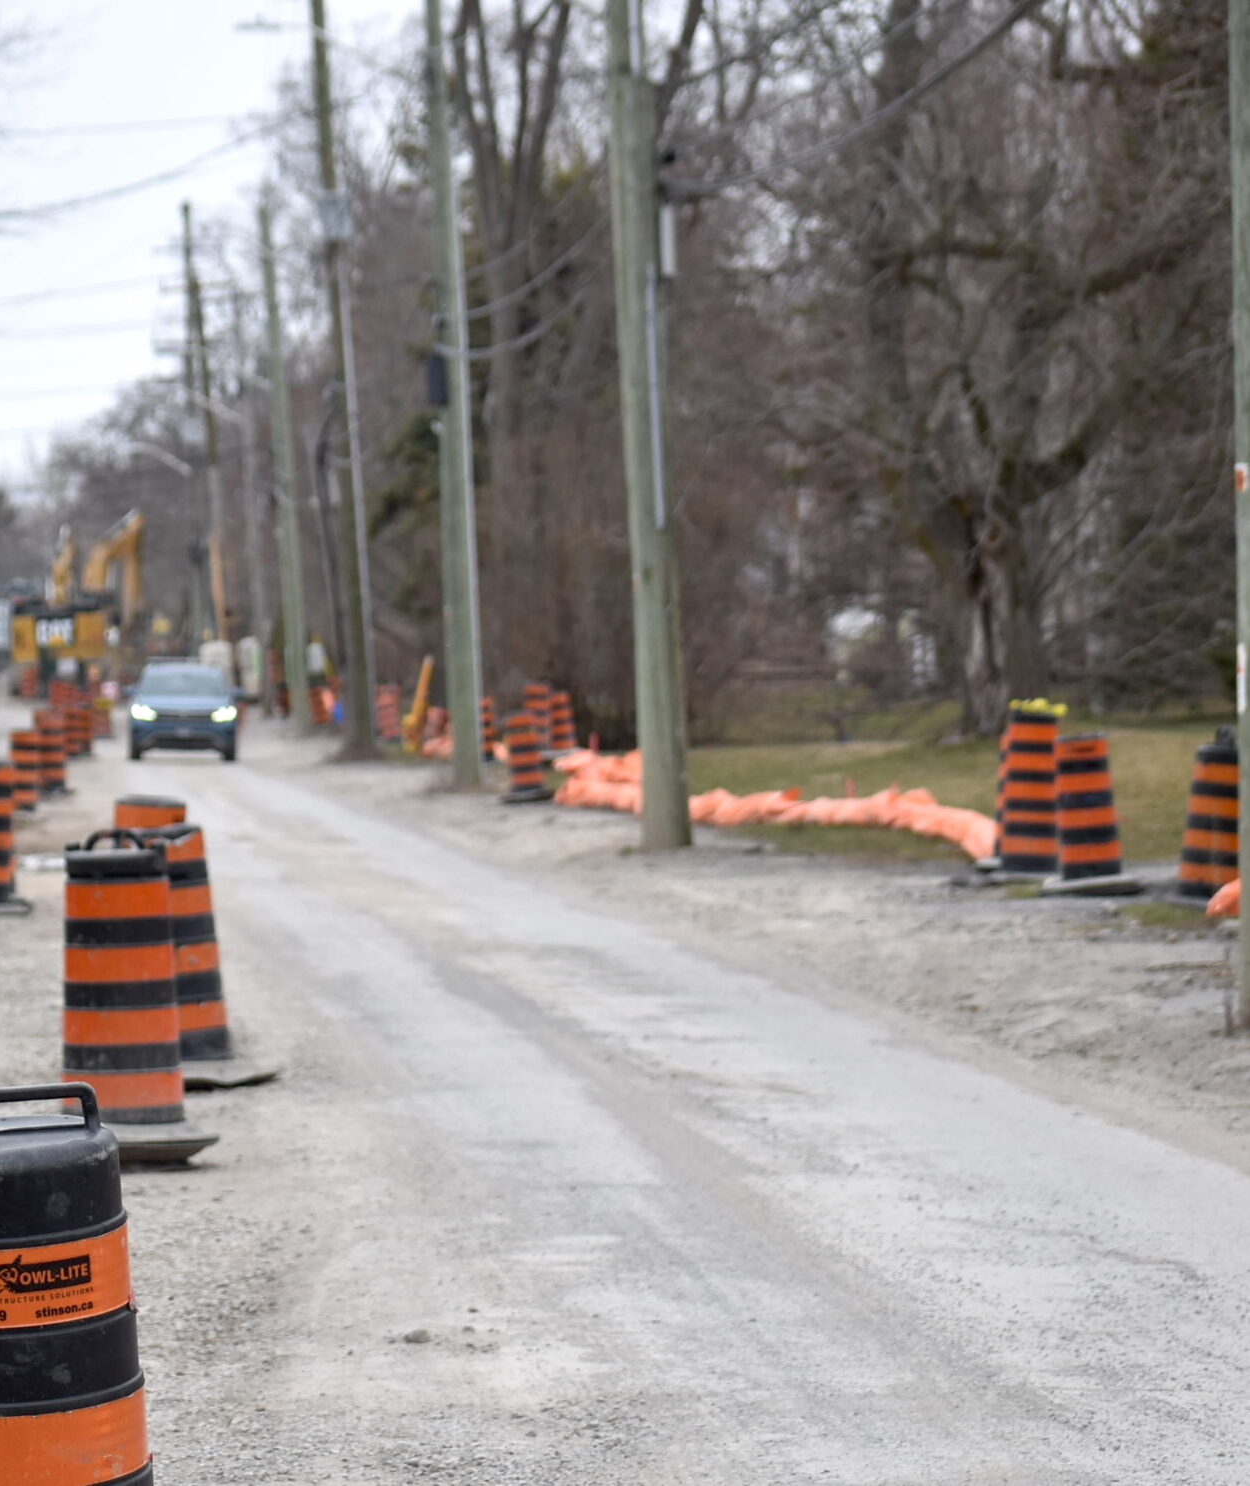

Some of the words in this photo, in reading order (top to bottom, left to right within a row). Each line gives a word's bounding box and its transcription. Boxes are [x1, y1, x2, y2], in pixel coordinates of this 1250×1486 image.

[19, 1262, 89, 1286] OWL-LITE
[49, 1286, 95, 1301] SOLUTIONS
[35, 1301, 94, 1319] stinson.ca
